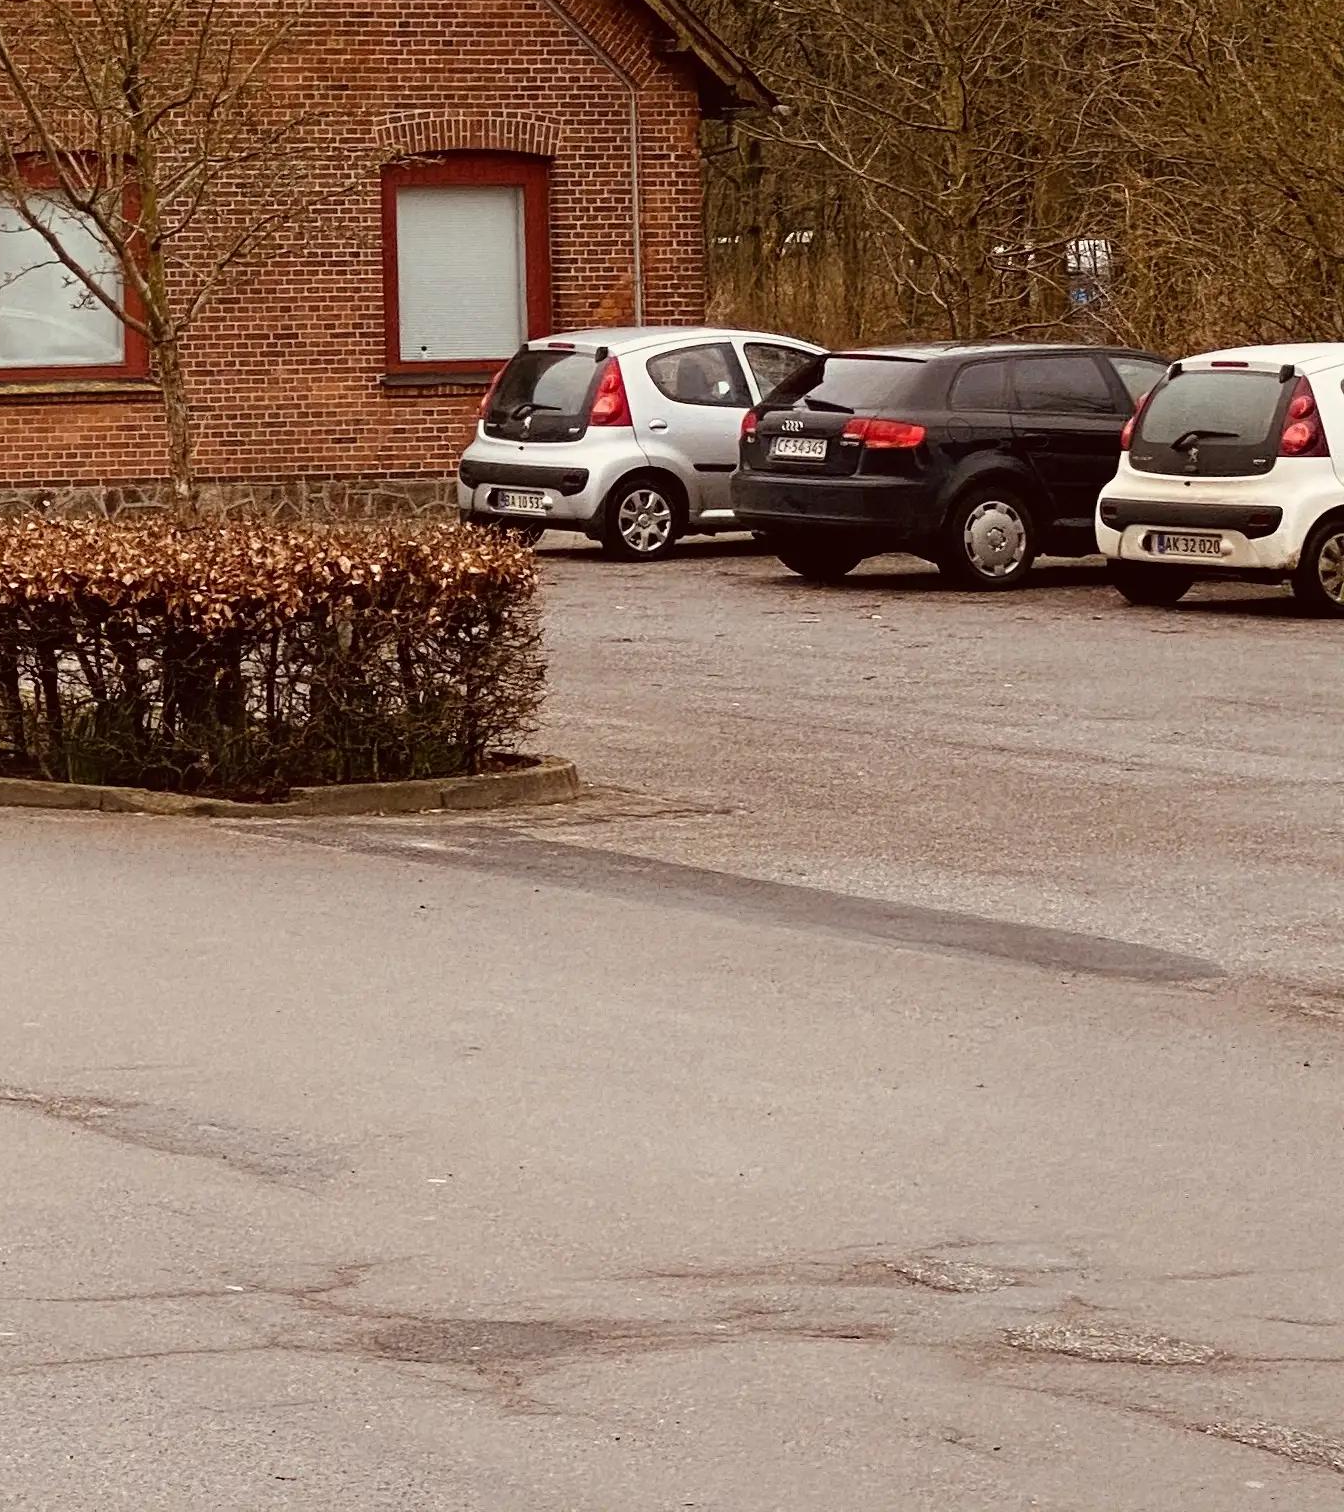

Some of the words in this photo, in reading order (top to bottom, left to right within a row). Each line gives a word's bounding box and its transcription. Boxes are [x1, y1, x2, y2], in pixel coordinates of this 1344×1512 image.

[1166, 536, 1180, 551] AK
[1181, 538, 1196, 553] 32
[1198, 539, 1221, 554] 020
